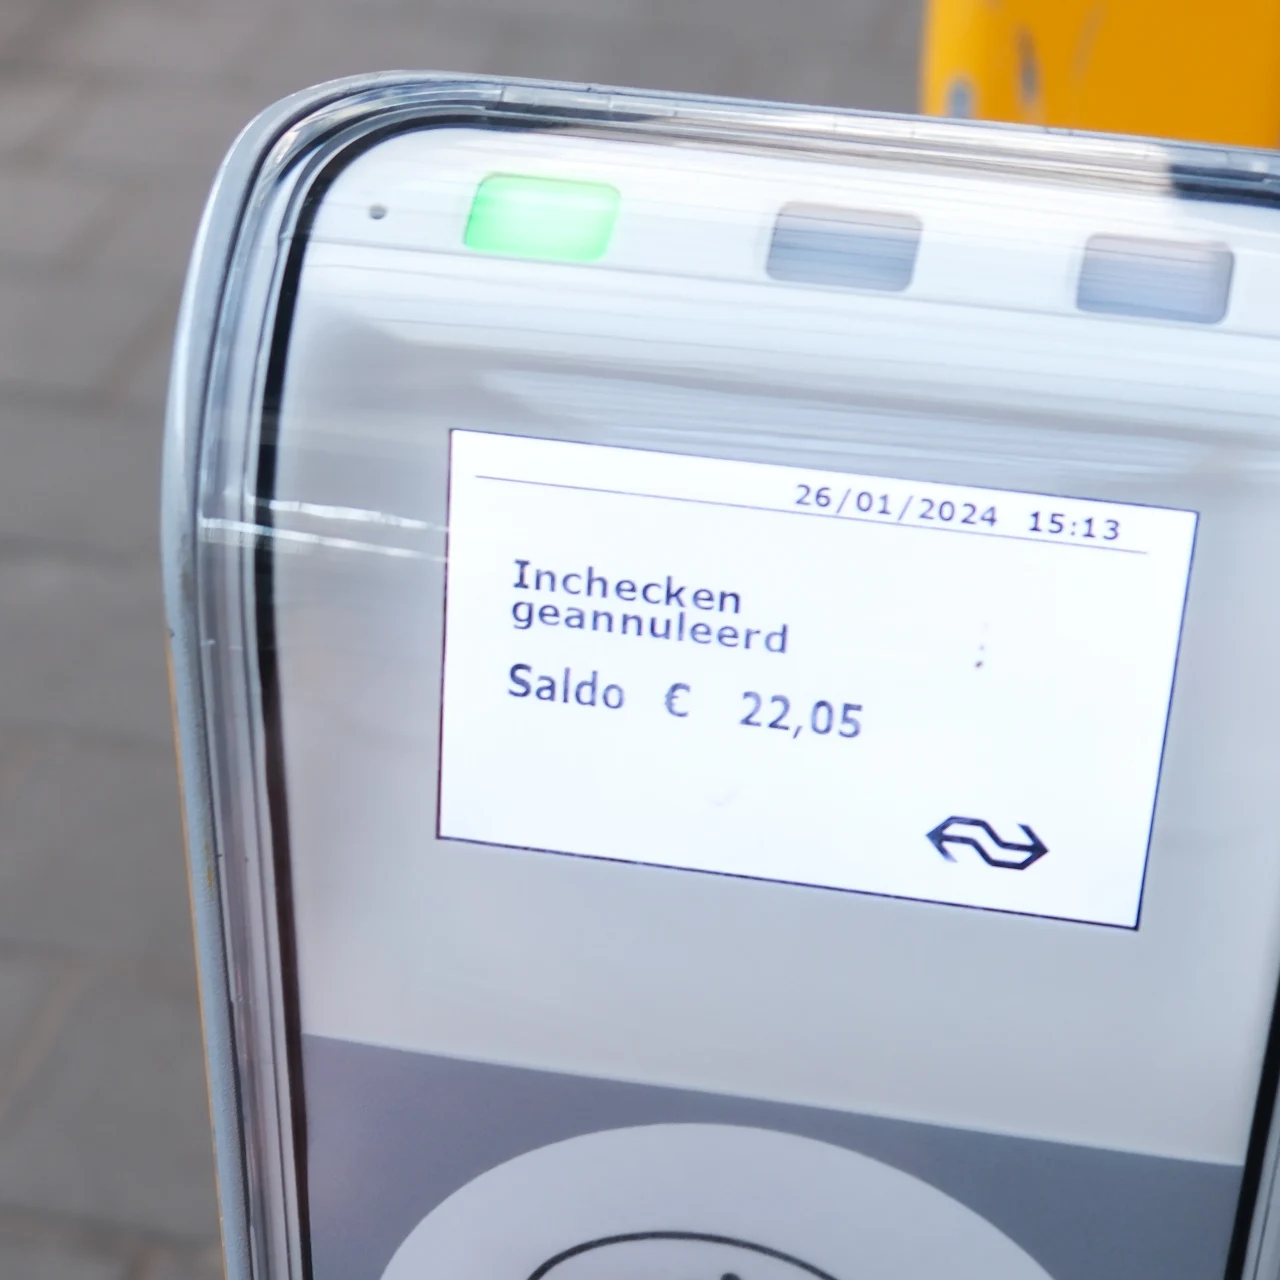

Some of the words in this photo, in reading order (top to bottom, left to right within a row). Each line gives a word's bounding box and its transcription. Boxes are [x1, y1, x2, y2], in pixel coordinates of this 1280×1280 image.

[795, 483, 998, 527] 26/01/2024
[1028, 510, 1120, 541] 15:13
[513, 559, 741, 614] Inchecken
[511, 600, 788, 654] geannuleerd
[508, 663, 624, 710] Saldo
[664, 682, 691, 718] €
[739, 691, 863, 740] 22,05
